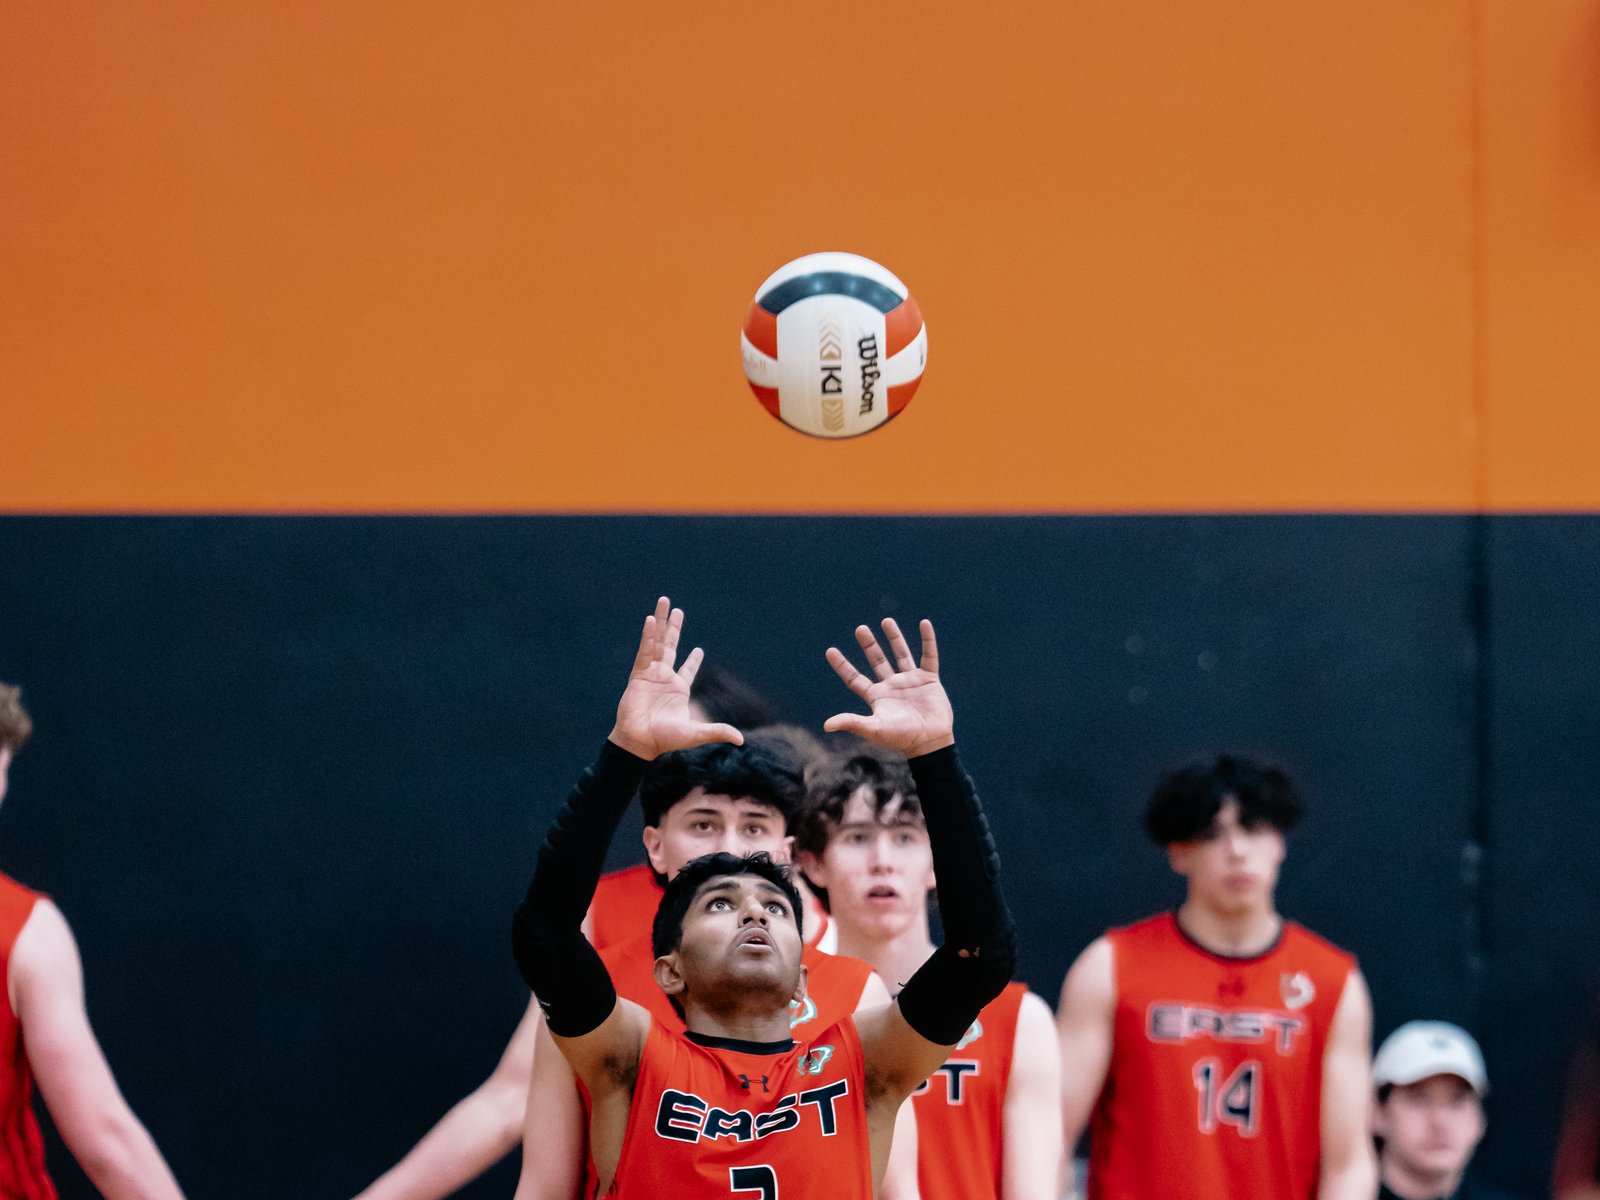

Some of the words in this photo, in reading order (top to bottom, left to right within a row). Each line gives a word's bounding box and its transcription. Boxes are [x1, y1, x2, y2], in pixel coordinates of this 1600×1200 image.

[857, 332, 881, 417] Wilson
[1147, 1002, 1304, 1055] EAST
[655, 1078, 848, 1143] EAST
[1193, 1058, 1262, 1137] 14
